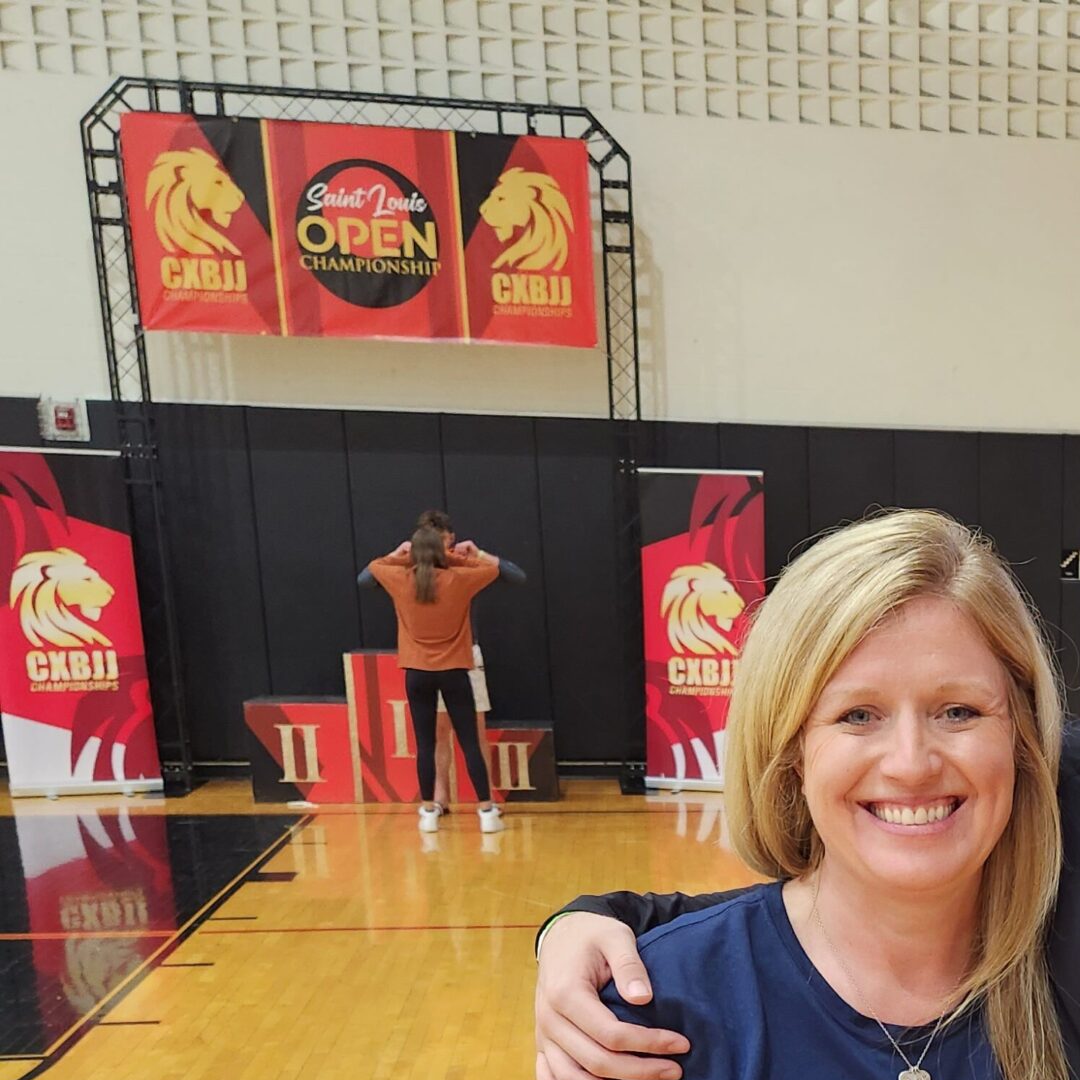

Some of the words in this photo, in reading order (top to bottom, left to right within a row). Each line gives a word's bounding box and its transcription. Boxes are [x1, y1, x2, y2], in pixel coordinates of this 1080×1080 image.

[306, 182, 366, 212] Saint
[366, 183, 427, 218] Louis
[297, 214, 437, 260] OPEN
[161, 255, 248, 292] CXBJJ
[299, 254, 442, 276] CHAMPIONSHIP
[491, 272, 572, 306] CXBJJ
[25, 650, 119, 682] CXBJJ
[30, 680, 119, 692] CHAMPIONSHIPS
